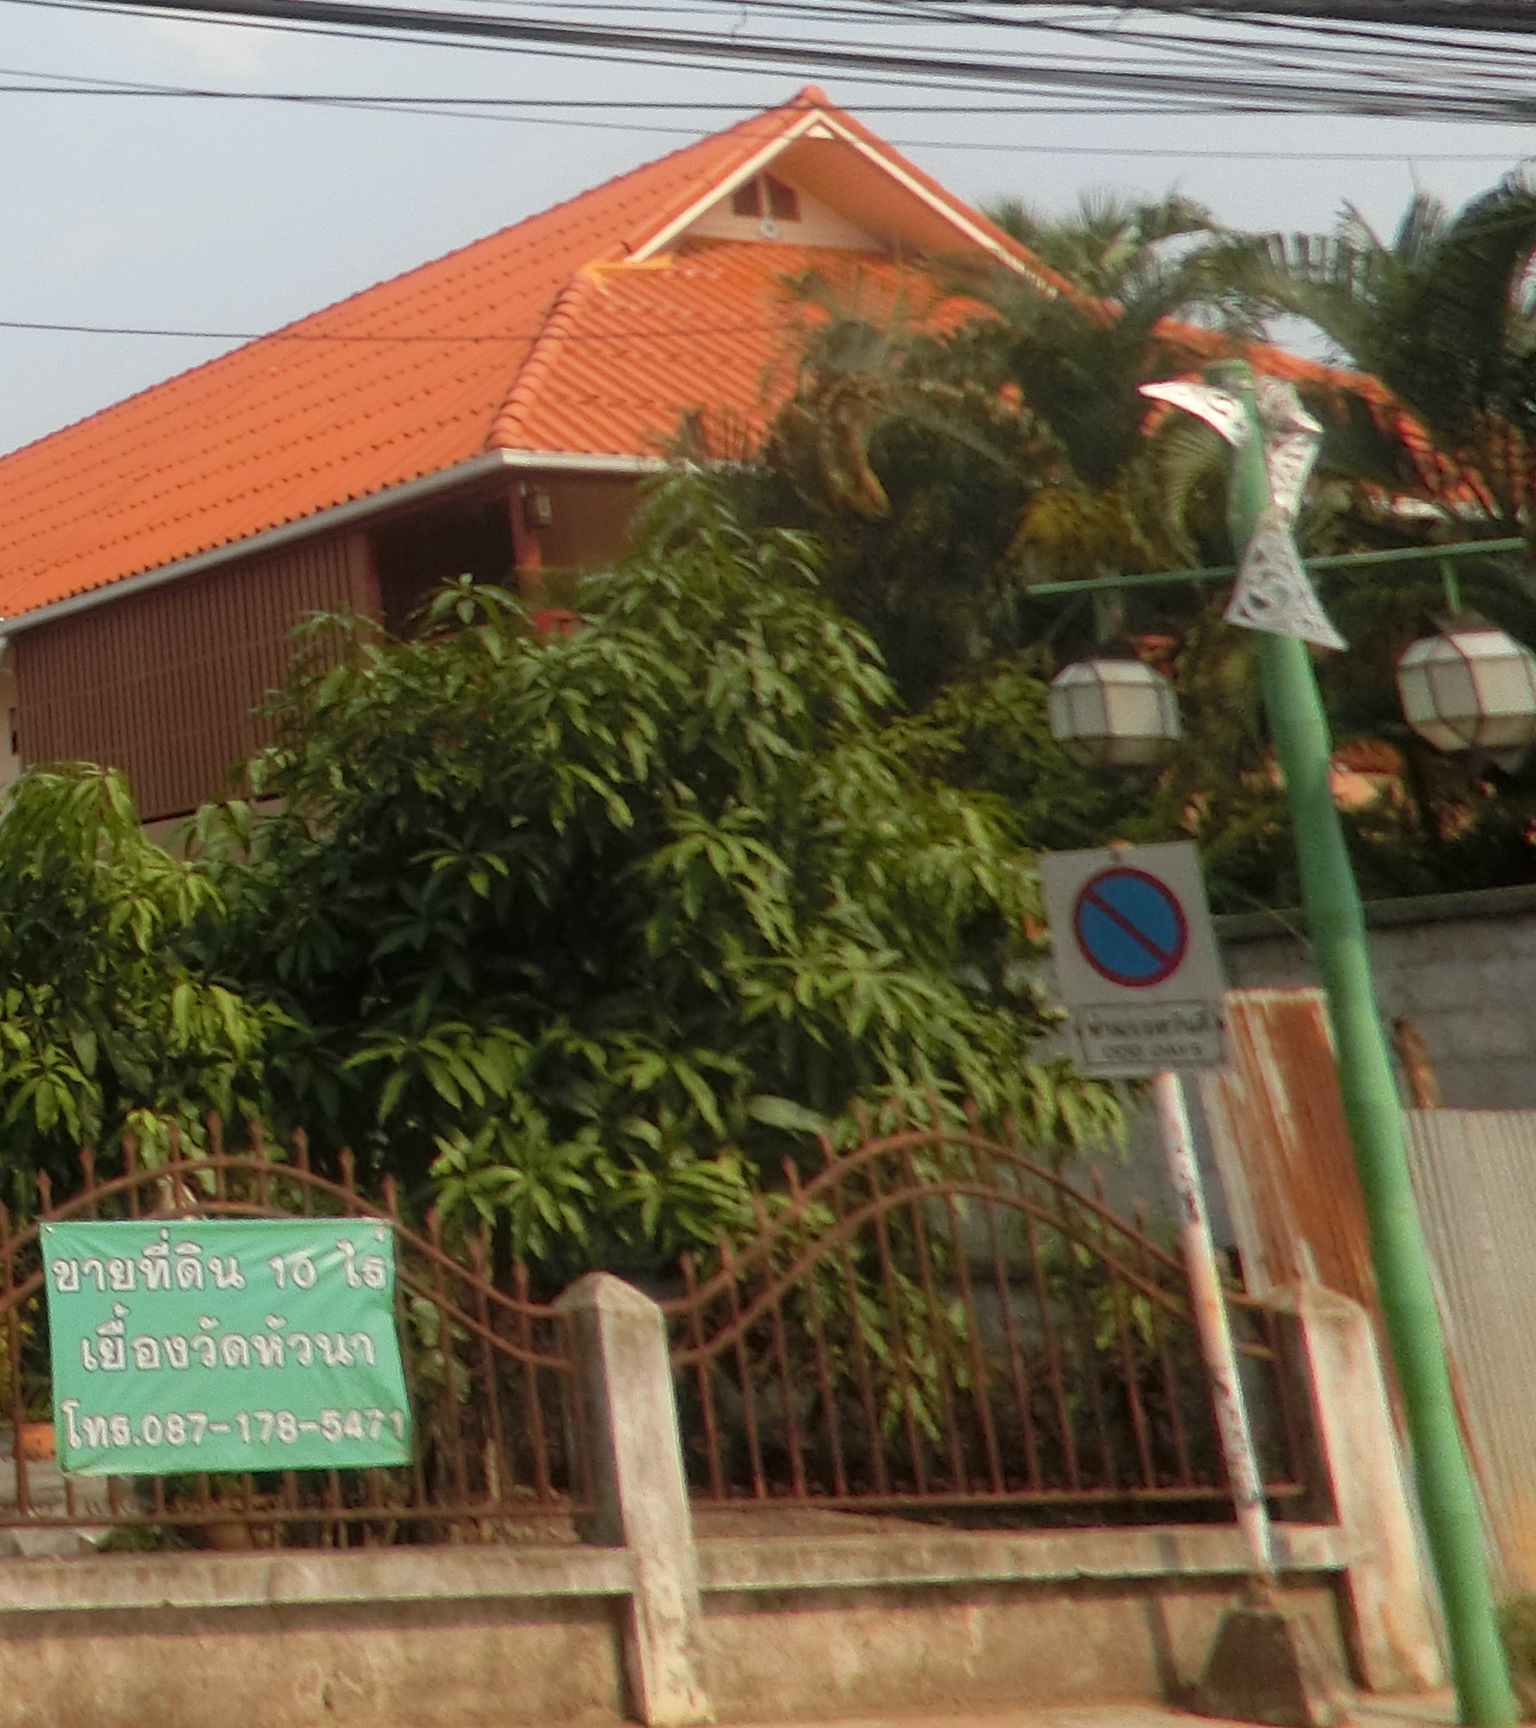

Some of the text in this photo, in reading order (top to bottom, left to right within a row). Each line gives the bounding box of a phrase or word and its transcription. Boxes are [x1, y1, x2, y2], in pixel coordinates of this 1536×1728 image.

[51, 1225, 388, 1293] ขายที่ดิน 10 ไร่
